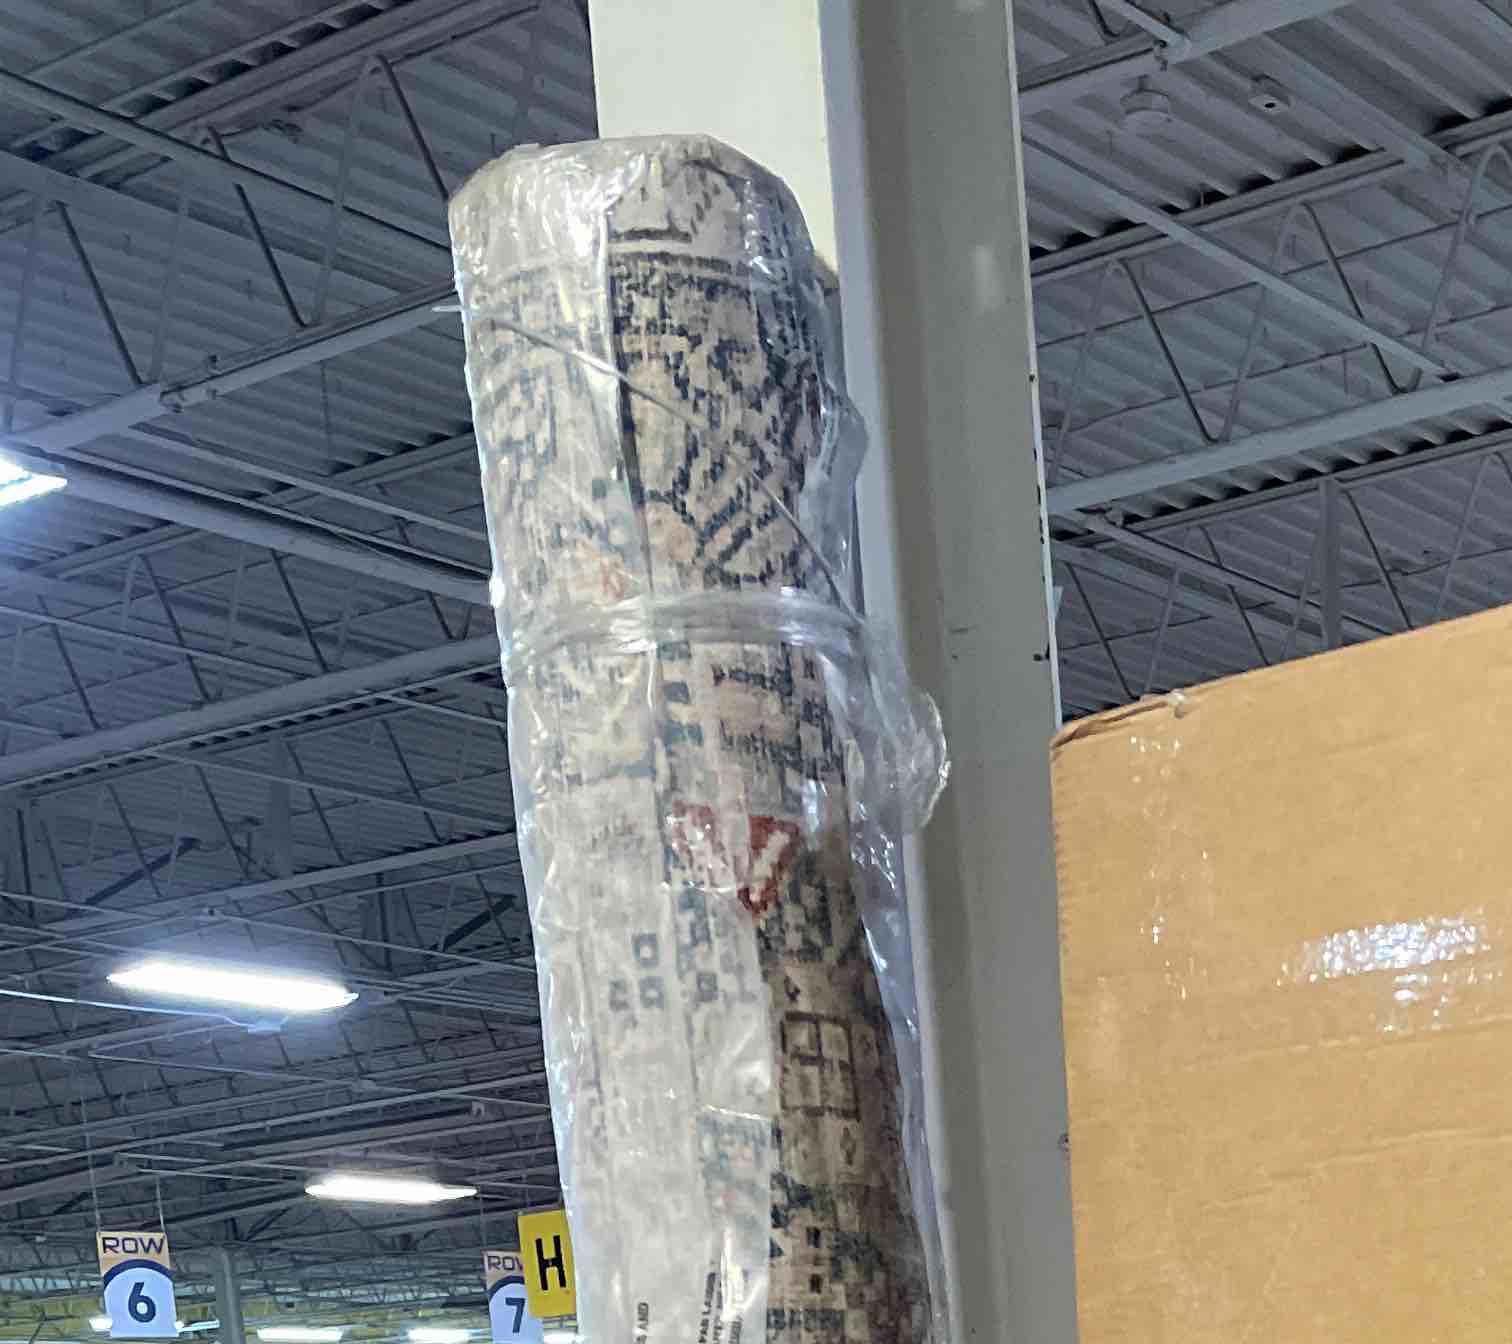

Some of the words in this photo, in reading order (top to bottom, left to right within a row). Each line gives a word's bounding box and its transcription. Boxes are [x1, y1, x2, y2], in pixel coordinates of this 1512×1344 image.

[102, 1236, 166, 1257] ROW
[535, 1235, 567, 1290] H
[127, 1283, 157, 1323] 6
[505, 1298, 526, 1333] 7
